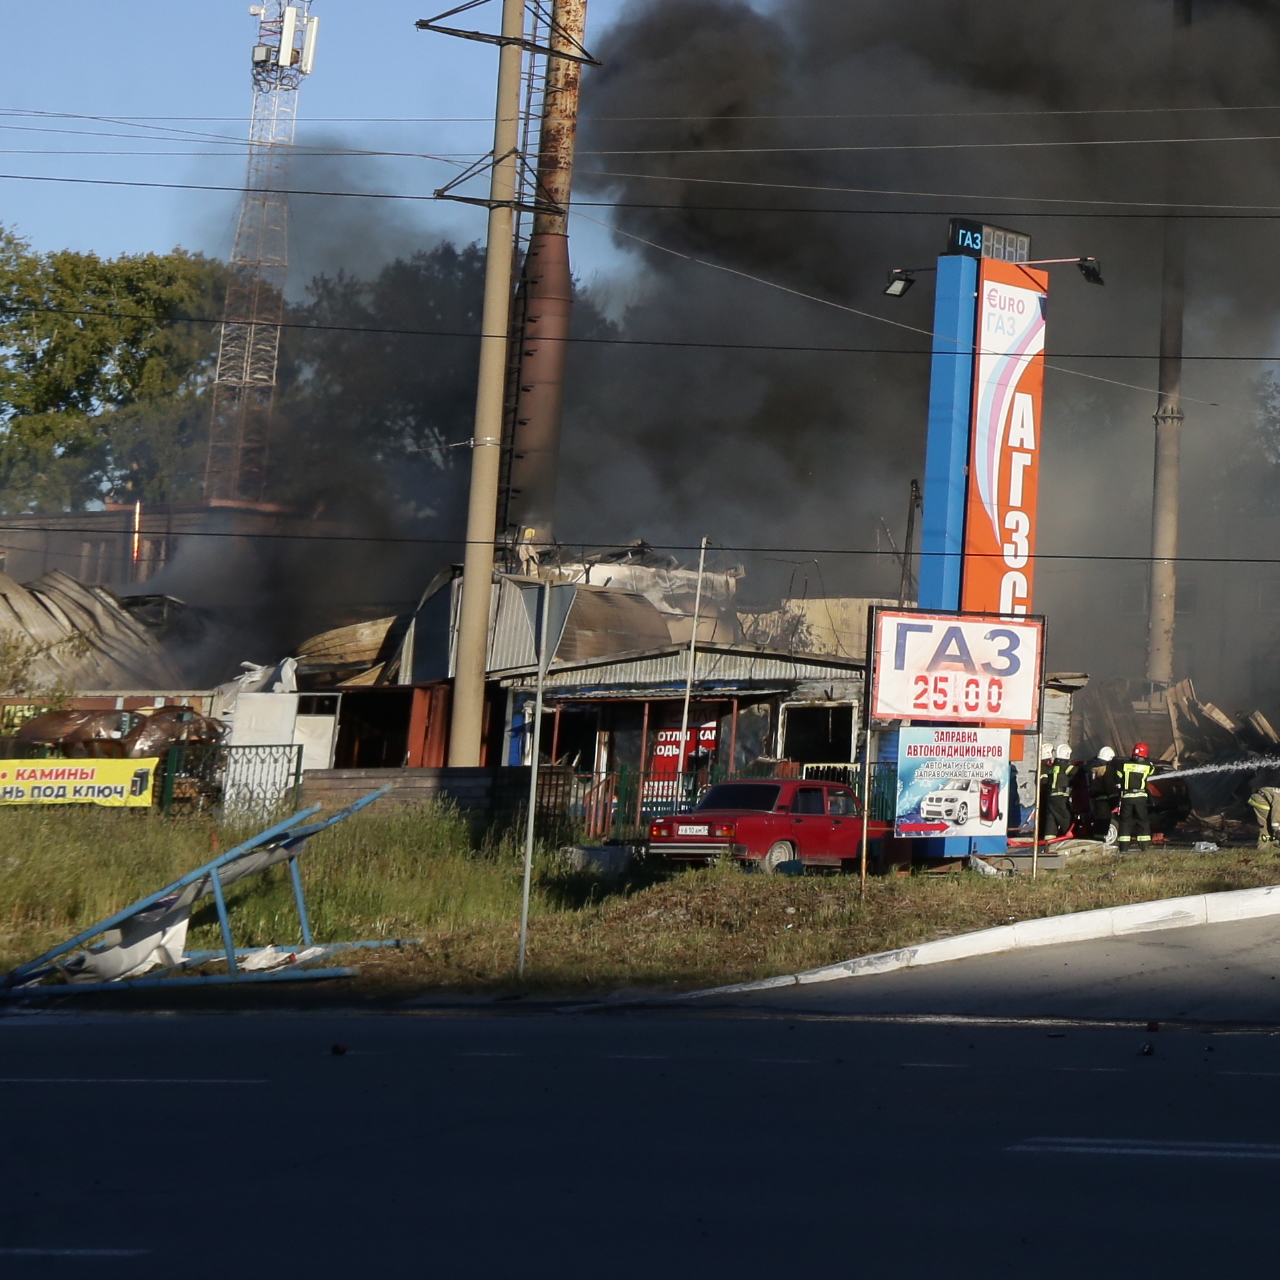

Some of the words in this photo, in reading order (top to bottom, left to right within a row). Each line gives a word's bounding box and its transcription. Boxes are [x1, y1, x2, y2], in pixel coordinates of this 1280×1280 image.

[958, 228, 982, 250] ГАЗ
[986, 311, 1017, 337] ГАЗ
[998, 392, 1036, 622] АГЗС
[893, 622, 1022, 677] ГАЗ
[912, 675, 1003, 714] 25.00
[934, 731, 978, 743] ЗАПРАВКА
[906, 745, 1003, 758] АВТОКОНДИЦИОНЕРОВ
[925, 761, 984, 770] АВТОМАТИЧЕСКАЯ
[15, 767, 96, 781] КАМИНЫ
[915, 770, 962, 779] ЗАПРАВОЧНАЯ
[963, 770, 993, 779] СТАНЦИЯ
[0, 785, 25, 799] НЬ
[30, 785, 67, 800] ПОД
[72, 784, 125, 799] КЛЮЧ
